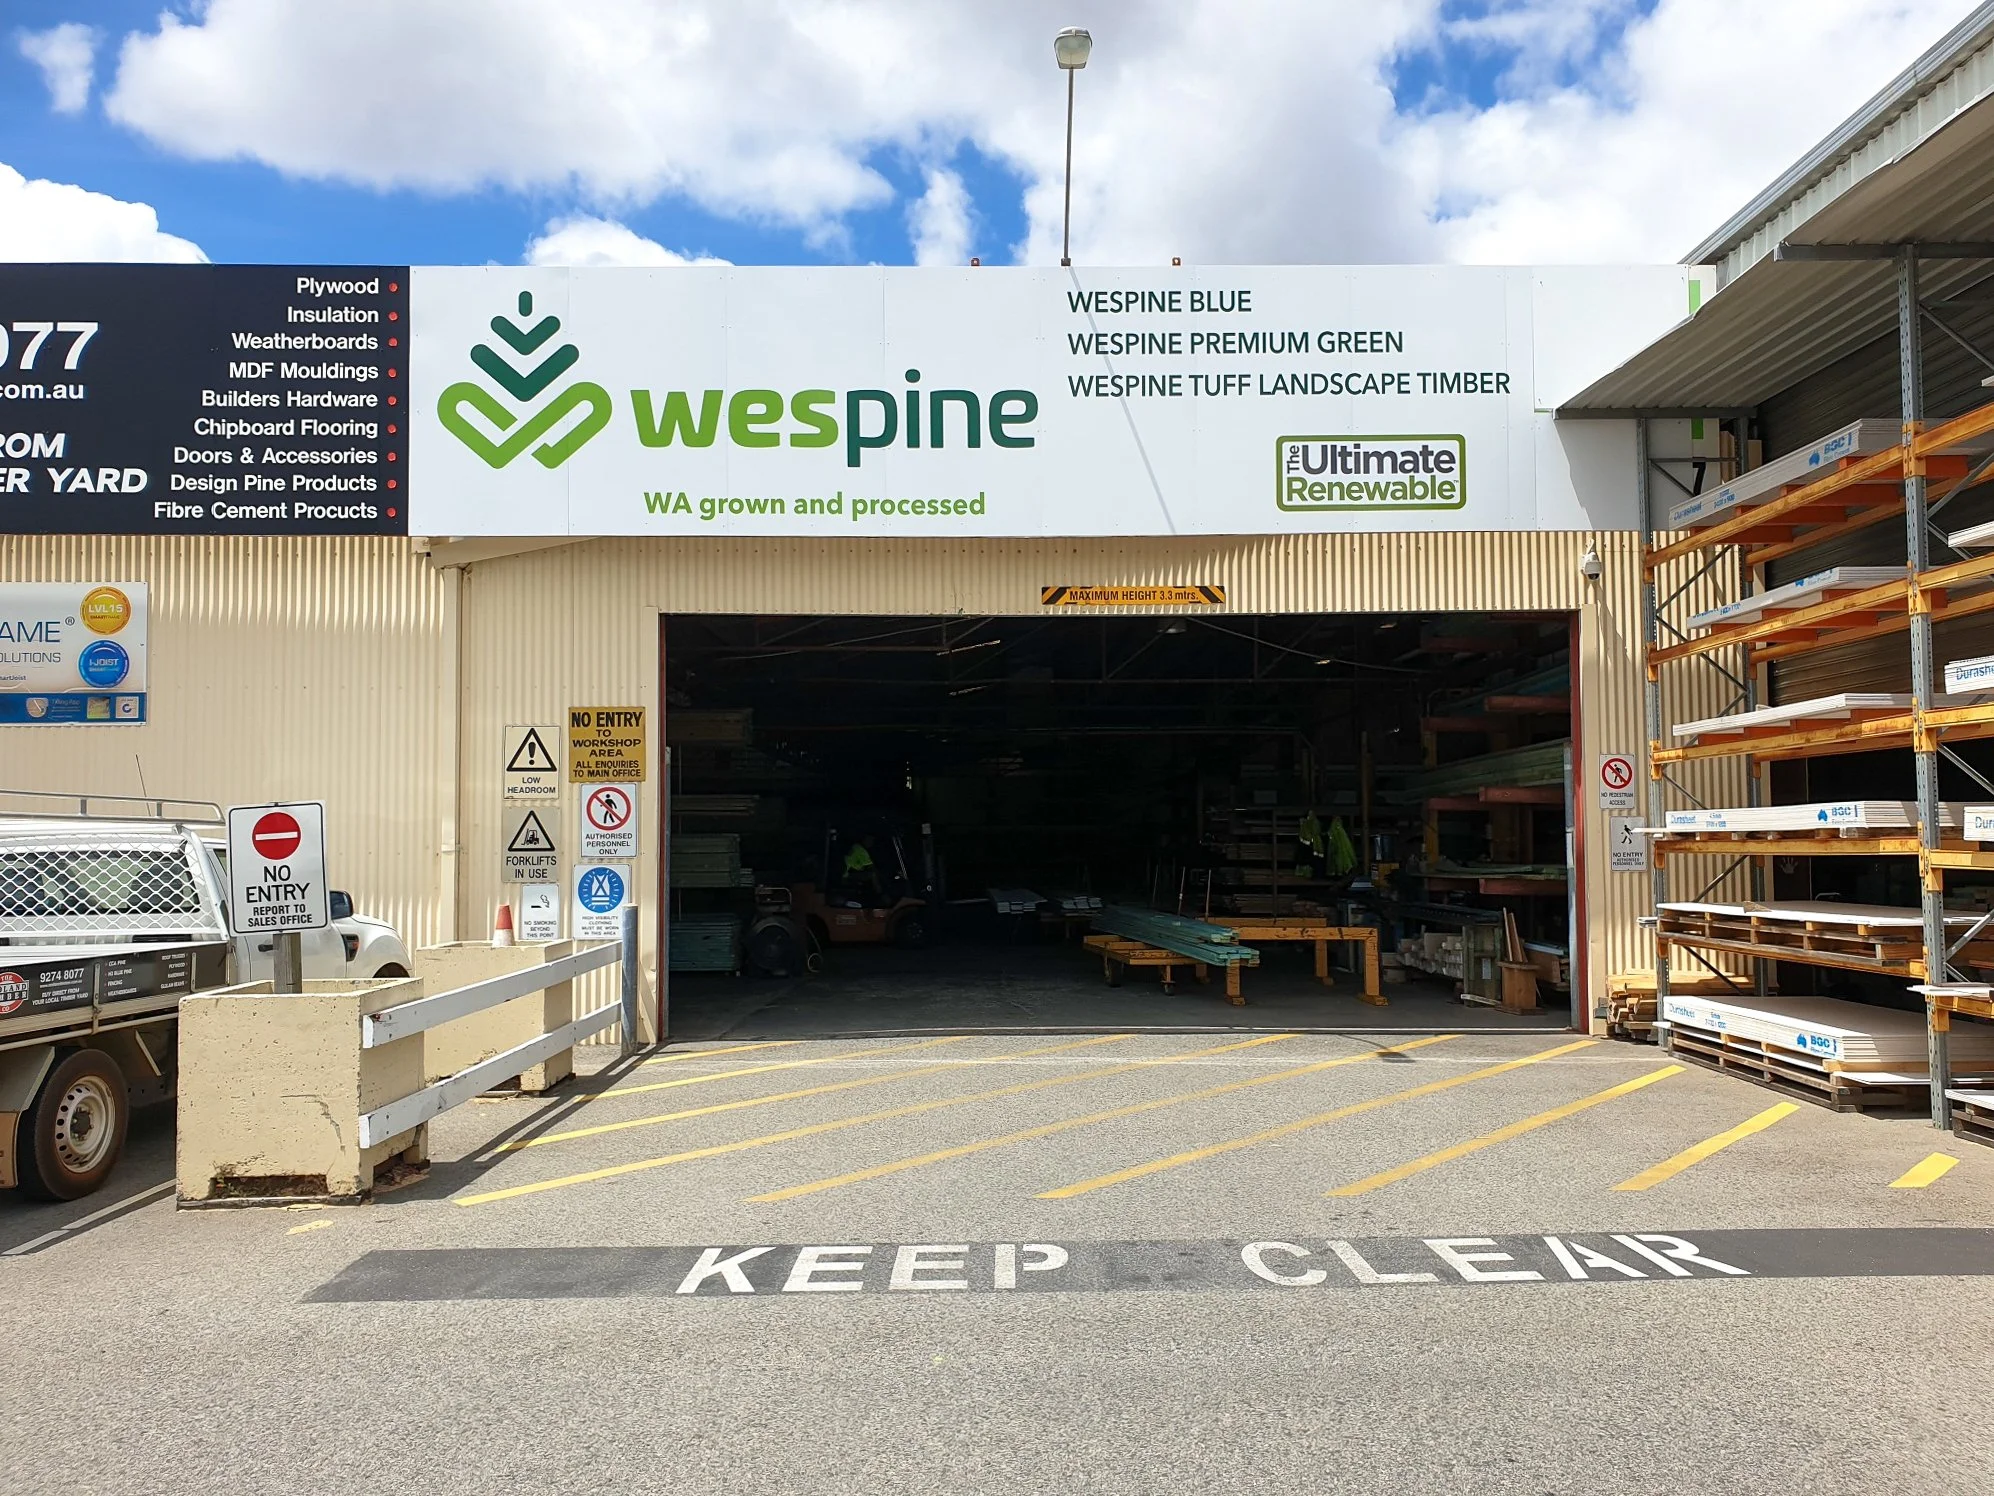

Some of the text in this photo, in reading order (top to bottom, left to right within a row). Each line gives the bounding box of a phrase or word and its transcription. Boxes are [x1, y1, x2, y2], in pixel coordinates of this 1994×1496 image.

[296, 277, 380, 297] Plywood
[1067, 290, 1252, 313] WESPINE BLUE
[287, 306, 379, 323] Insulation
[0, 321, 99, 370] 77
[231, 332, 379, 350] Weatherboards
[1067, 330, 1403, 355] WESPINE PREMIUM GREEN
[229, 361, 379, 382] MDF Mouldings
[0, 384, 84, 399] om.au
[1068, 372, 1511, 397] WESPINE TUFF LANDSCAPE TIMBER
[201, 389, 379, 407] Builders Hardware
[630, 368, 1039, 467] wespine
[193, 417, 379, 439] Chipboard Flooring
[0, 432, 66, 459] OM
[1824, 435, 1845, 454] BGC
[174, 446, 378, 464] Doors & Accessories
[1286, 443, 1456, 475] The Ultimate
[46, 467, 149, 493] YARD
[170, 473, 378, 494] Design Pine Products
[153, 501, 204, 519] Fibre
[211, 501, 288, 519] Cement
[643, 491, 985, 522] WA grown and processed
[1070, 590, 1199, 601] MAXIMUM HEIGHT 3.3 mtrs.
[571, 711, 643, 728] NO ENTRY
[595, 729, 611, 738] TO
[572, 738, 641, 748] WORKSHOP
[589, 749, 624, 758] AREA
[573, 769, 641, 777] TO MAIN OFFICE
[575, 760, 639, 769] ALL ENQUIRIES
[507, 786, 556, 794] HEADROOM
[1832, 806, 1851, 816] BGC
[586, 840, 631, 848] PERSONNEL
[505, 855, 557, 866] FORKLIFTS
[263, 864, 291, 882] NO
[514, 868, 548, 879] IN USE
[245, 882, 310, 904] ENTRY
[253, 903, 306, 917] REPORT TO
[248, 914, 313, 928] SALES OFFICE
[40, 968, 84, 983] 9274 8077
[1810, 1035, 1830, 1048] BGC
[675, 1233, 1753, 1294] KEEP CLEAR
